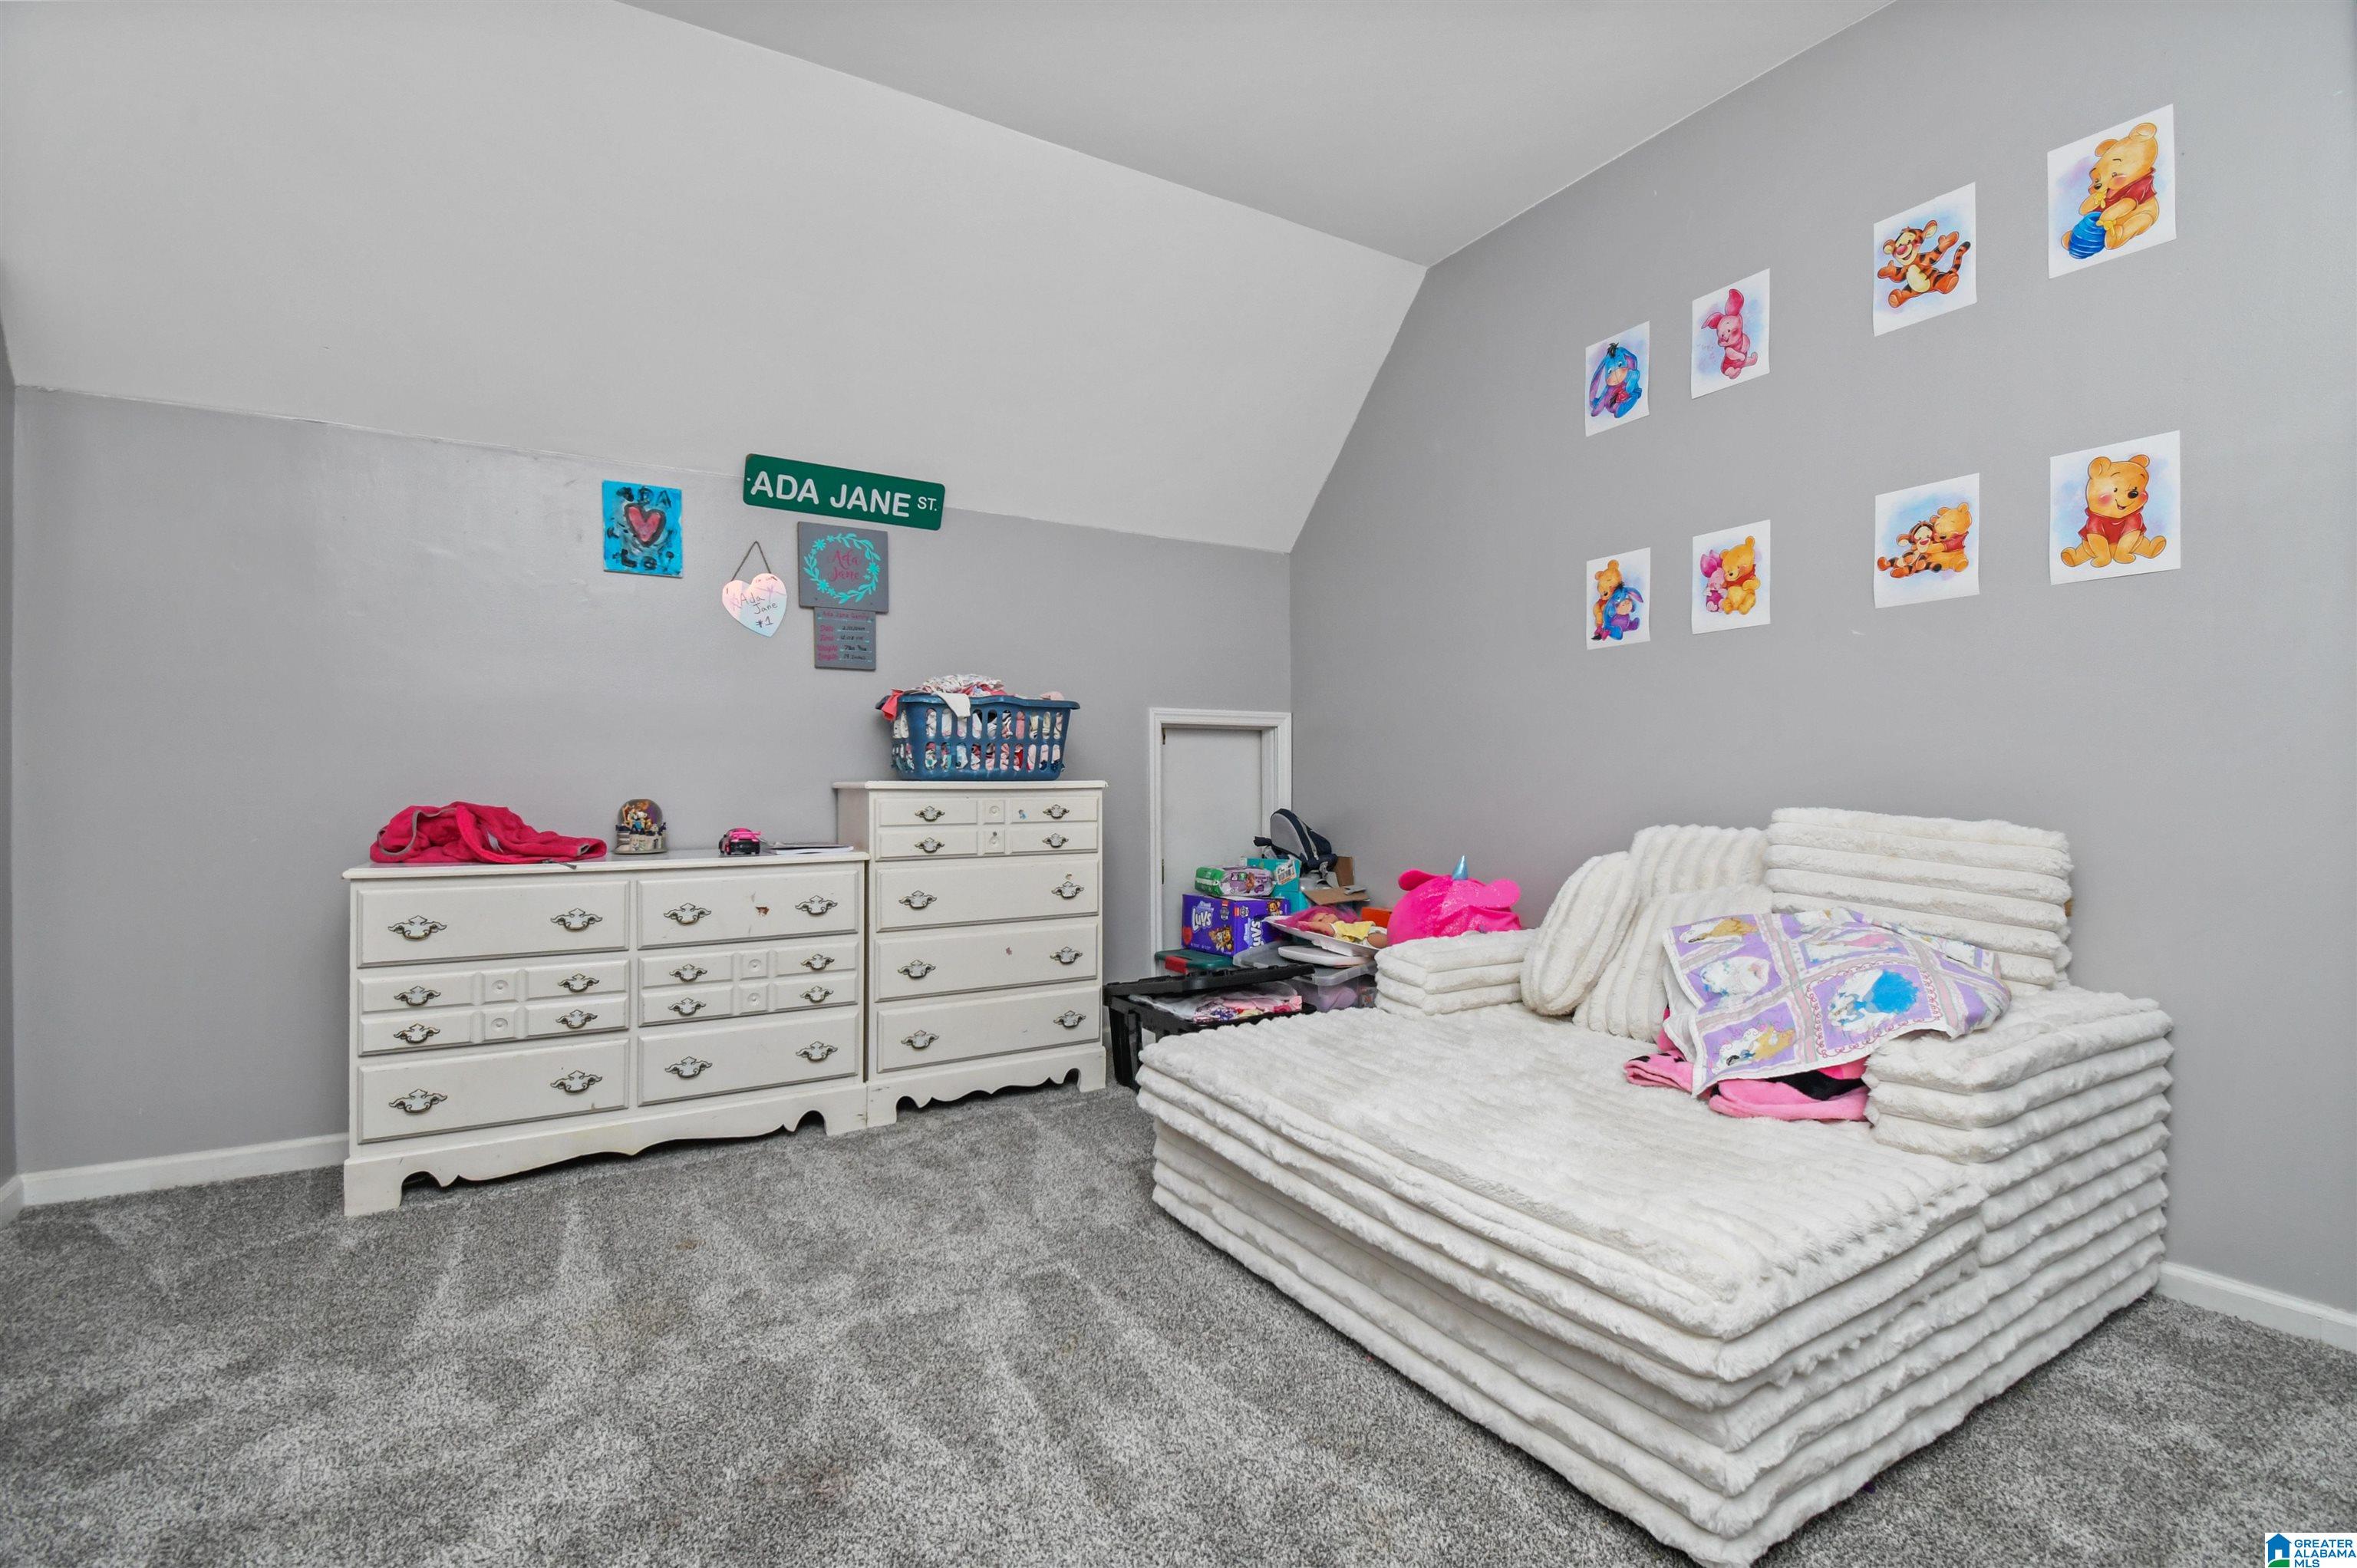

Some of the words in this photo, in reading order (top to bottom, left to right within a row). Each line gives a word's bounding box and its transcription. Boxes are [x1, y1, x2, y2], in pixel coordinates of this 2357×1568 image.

[750, 471, 819, 505] ADA
[829, 484, 911, 518] JANE
[917, 496, 938, 511] ST.
[740, 592, 765, 606] Ada
[753, 602, 778, 614] Jane
[1249, 921, 1264, 950] uvs
